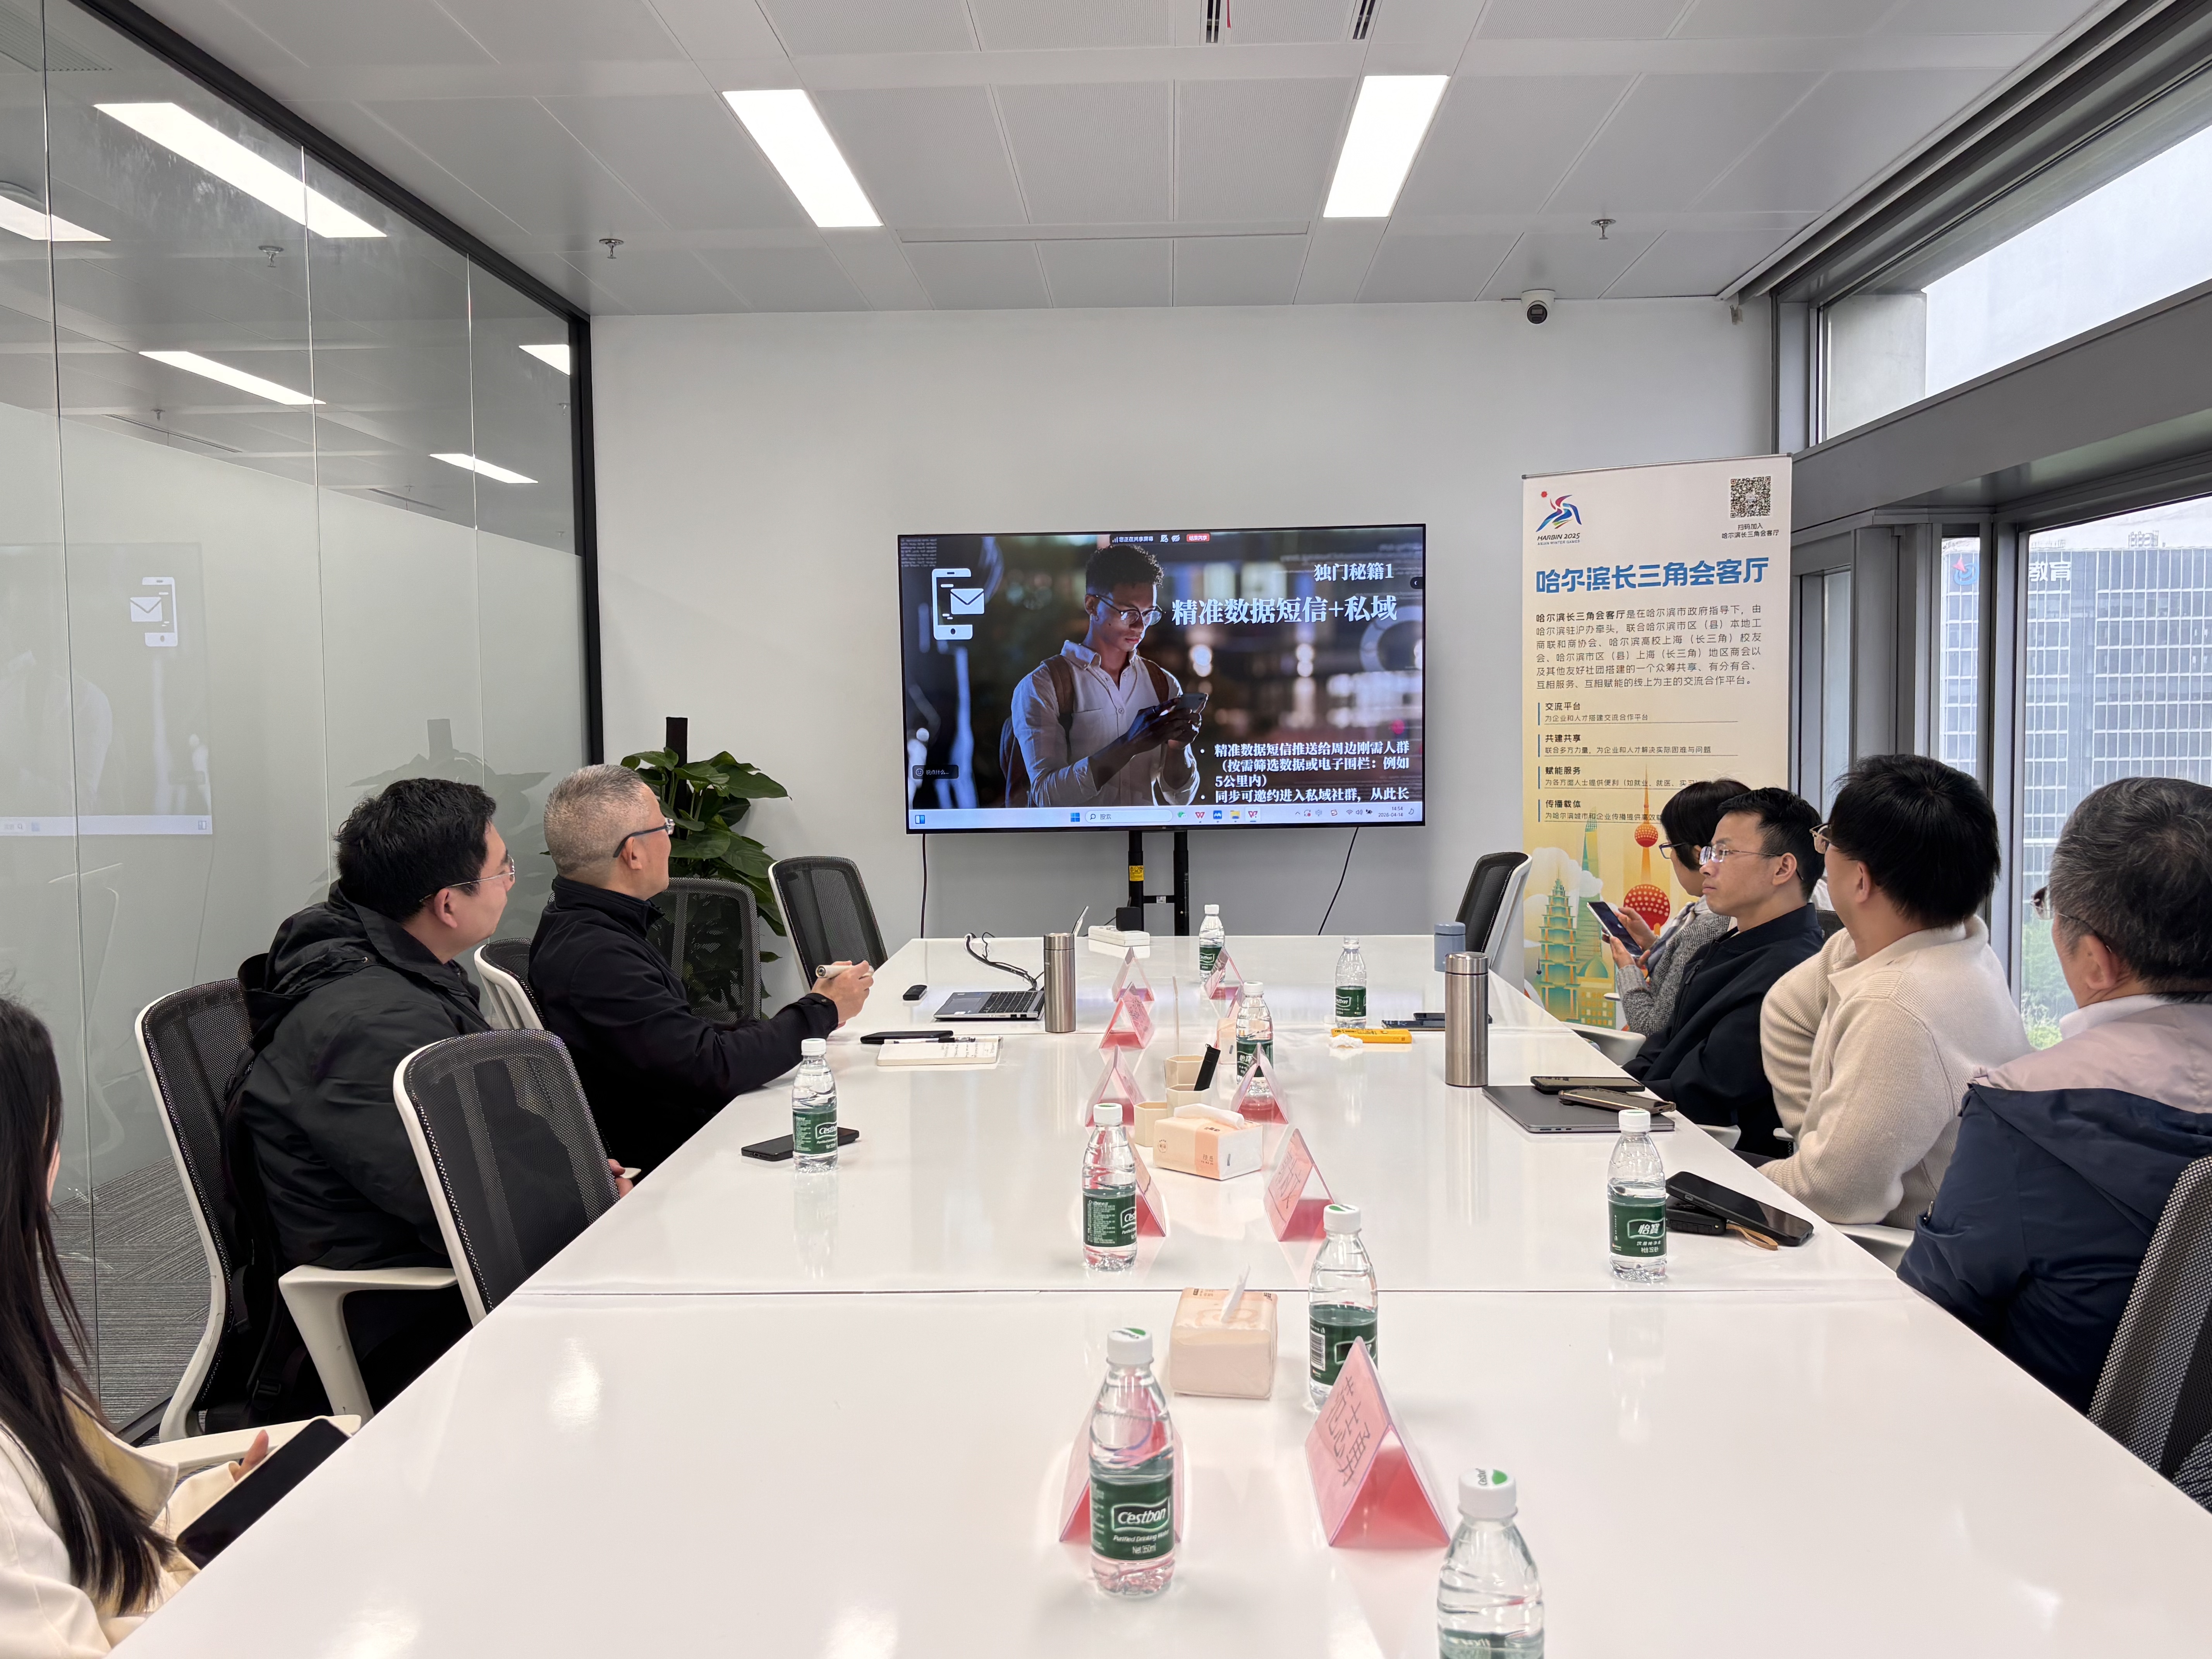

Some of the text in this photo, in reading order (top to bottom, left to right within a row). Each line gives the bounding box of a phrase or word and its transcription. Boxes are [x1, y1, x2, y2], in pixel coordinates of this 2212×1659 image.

[1721, 529, 1779, 539] 哈尔滨长三角会客厅
[1314, 562, 1395, 582] 独门秘籍1
[1536, 557, 1769, 593] 哈尔滨长三角会客厅
[1171, 595, 1398, 626] 精准数据短信+私域
[1545, 702, 1581, 711] 交流平台
[1545, 713, 1648, 722] 为企业和人才搭建交流合作平台
[1545, 733, 1581, 743] 共建共享
[1545, 766, 1581, 776] 赋能服务
[1545, 800, 1581, 809] 传播载体
[1325, 1375, 1370, 1487] 范志勇
[1136, 1534, 1157, 1542] Drinking
